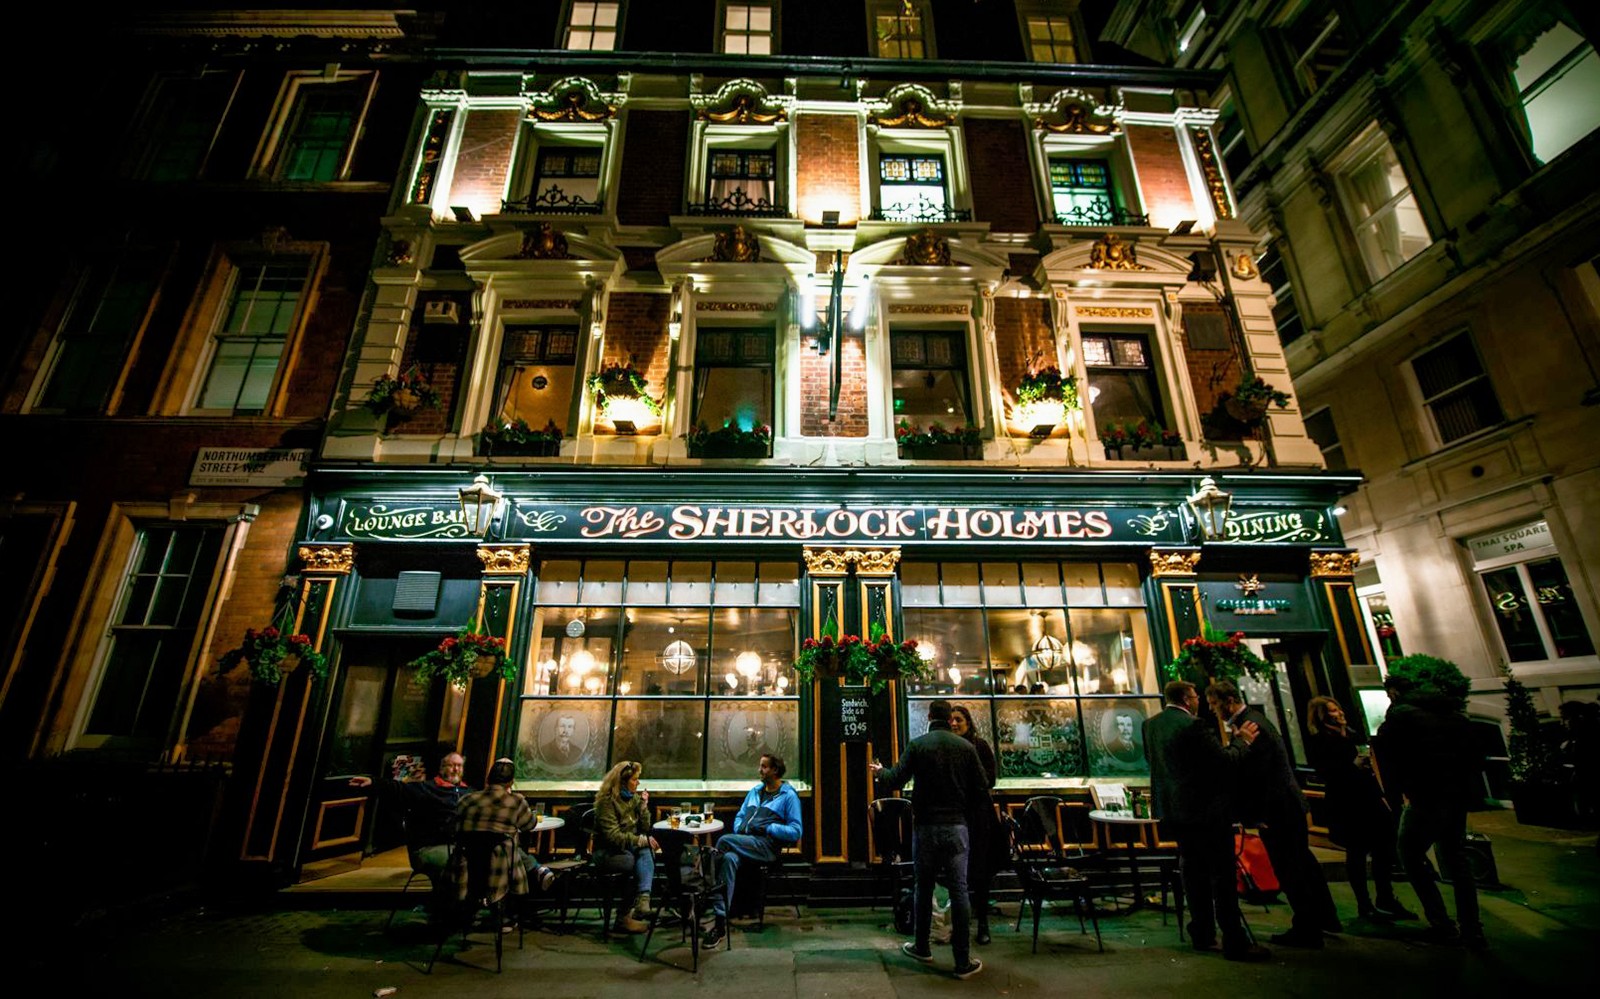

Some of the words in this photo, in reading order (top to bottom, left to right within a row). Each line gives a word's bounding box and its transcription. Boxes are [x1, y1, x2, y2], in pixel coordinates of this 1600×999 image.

[202, 451, 305, 462] NORTHUMBERLAND
[199, 463, 238, 473] STREET
[242, 464, 266, 474] WC2
[354, 512, 427, 531] LOUNGE
[580, 506, 665, 539] The
[668, 505, 916, 540] SHERLOCK
[926, 508, 1113, 540] HOLMES
[1225, 513, 1303, 537] DINING
[1476, 537, 1501, 549] THAI
[1503, 524, 1548, 543] SQUARE
[1504, 542, 1526, 553] SPA
[841, 714, 858, 723] Drink
